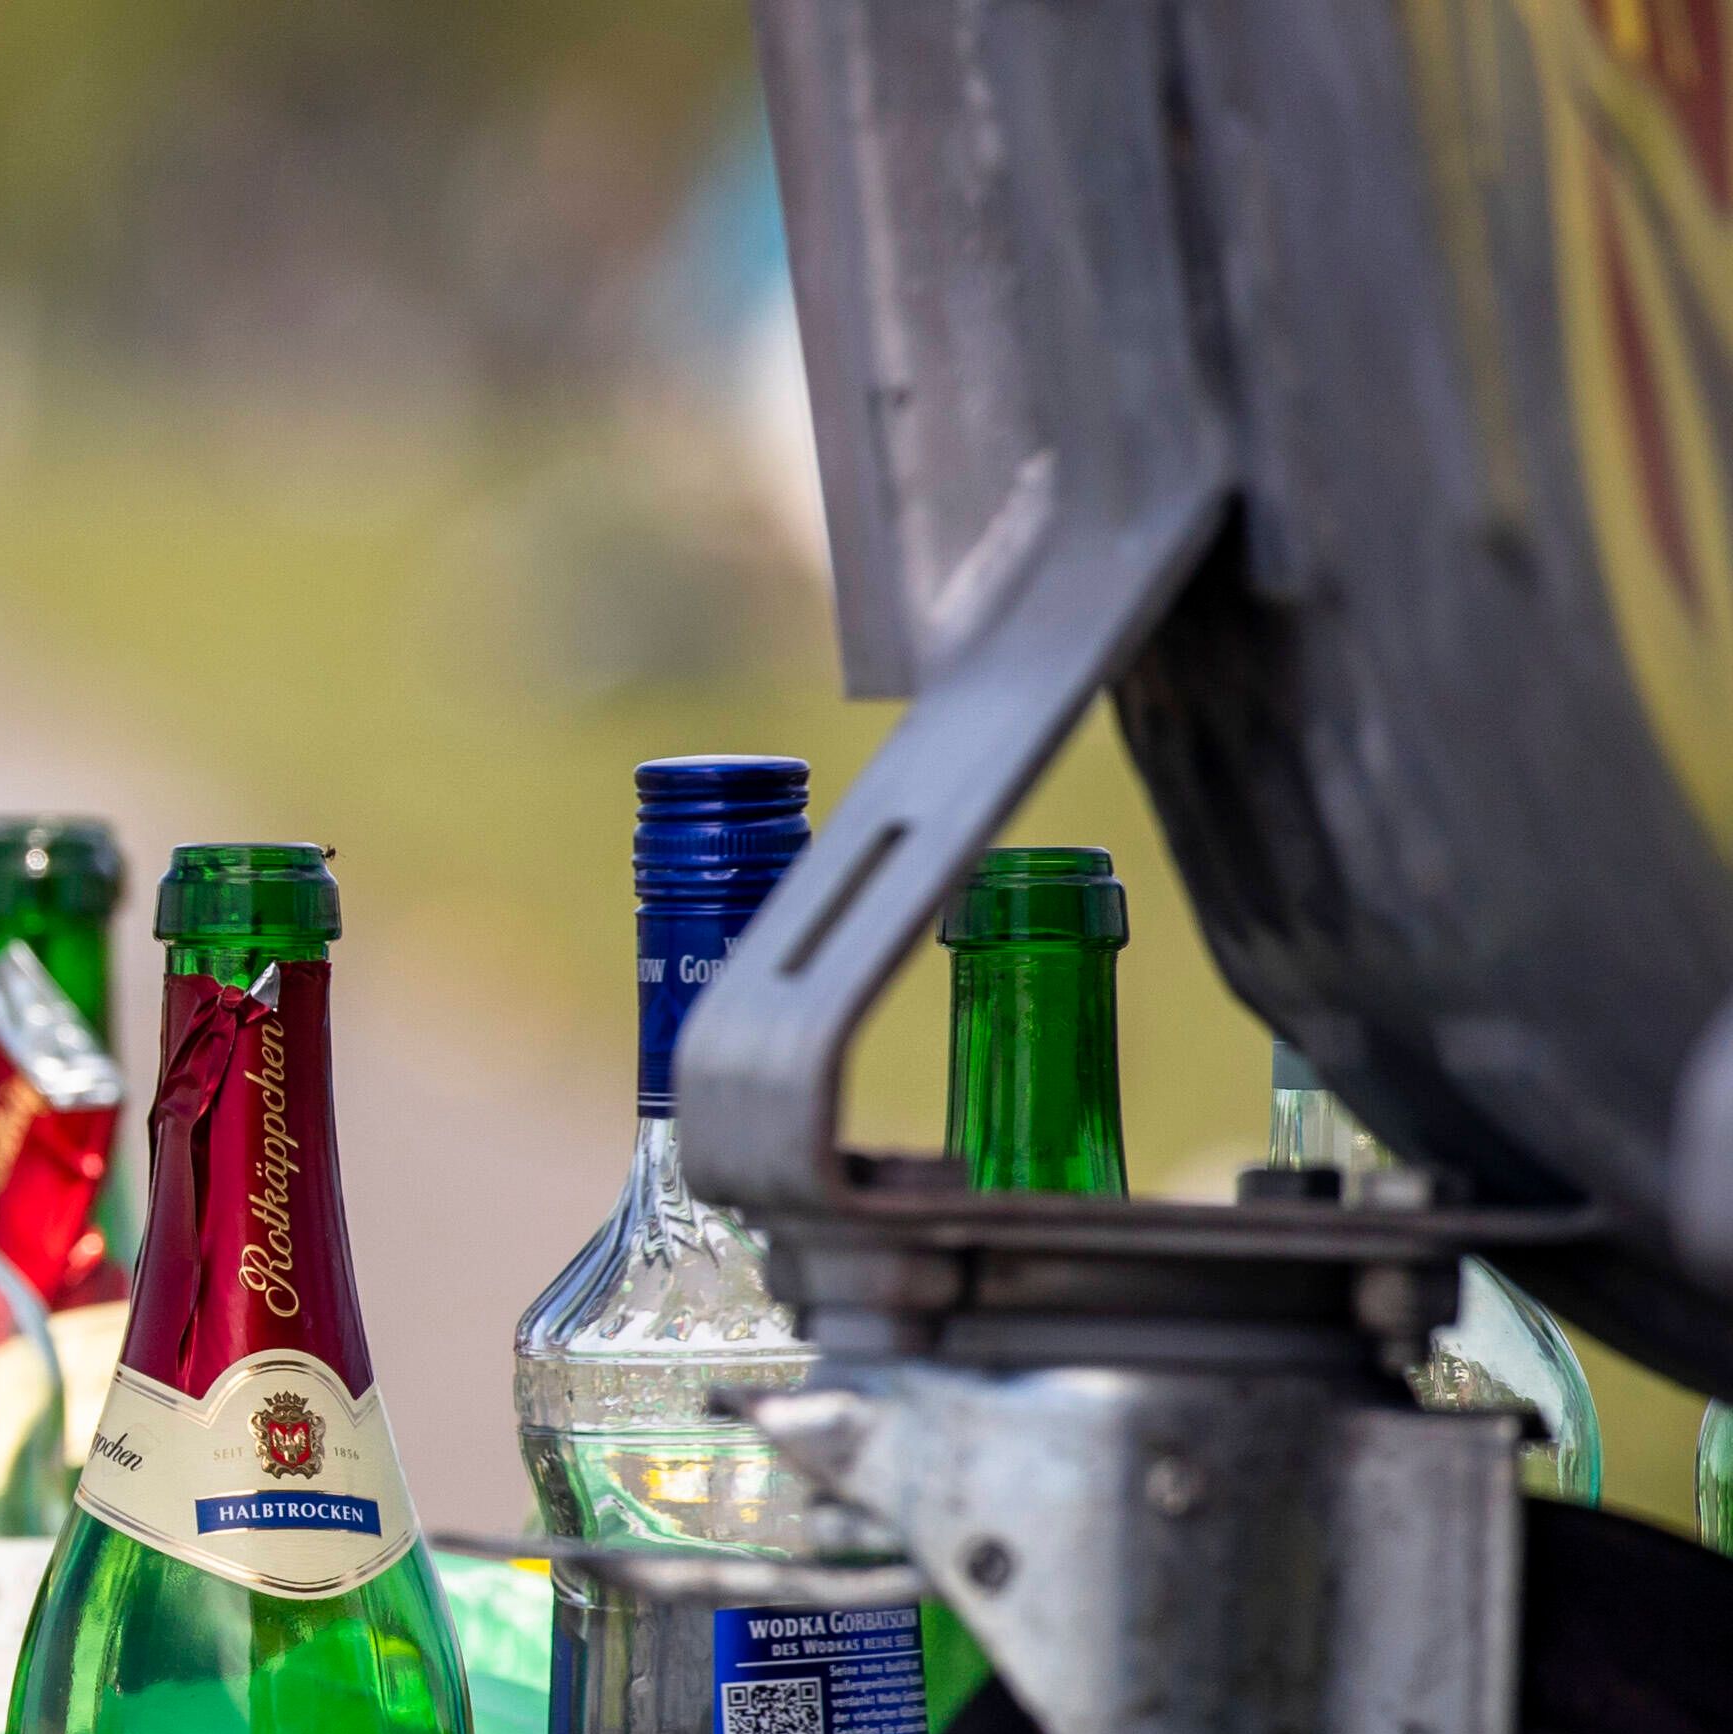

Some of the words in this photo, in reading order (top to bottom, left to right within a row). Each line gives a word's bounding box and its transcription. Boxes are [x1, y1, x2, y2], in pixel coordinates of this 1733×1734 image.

[238, 1018, 300, 1318] Rotkäppchen
[213, 1446, 244, 1461] SEIT
[333, 1446, 361, 1461] 1856
[219, 1502, 364, 1524] HALBTROCKEN
[747, 1615, 827, 1640] WODKA
[771, 1642, 799, 1657] DES
